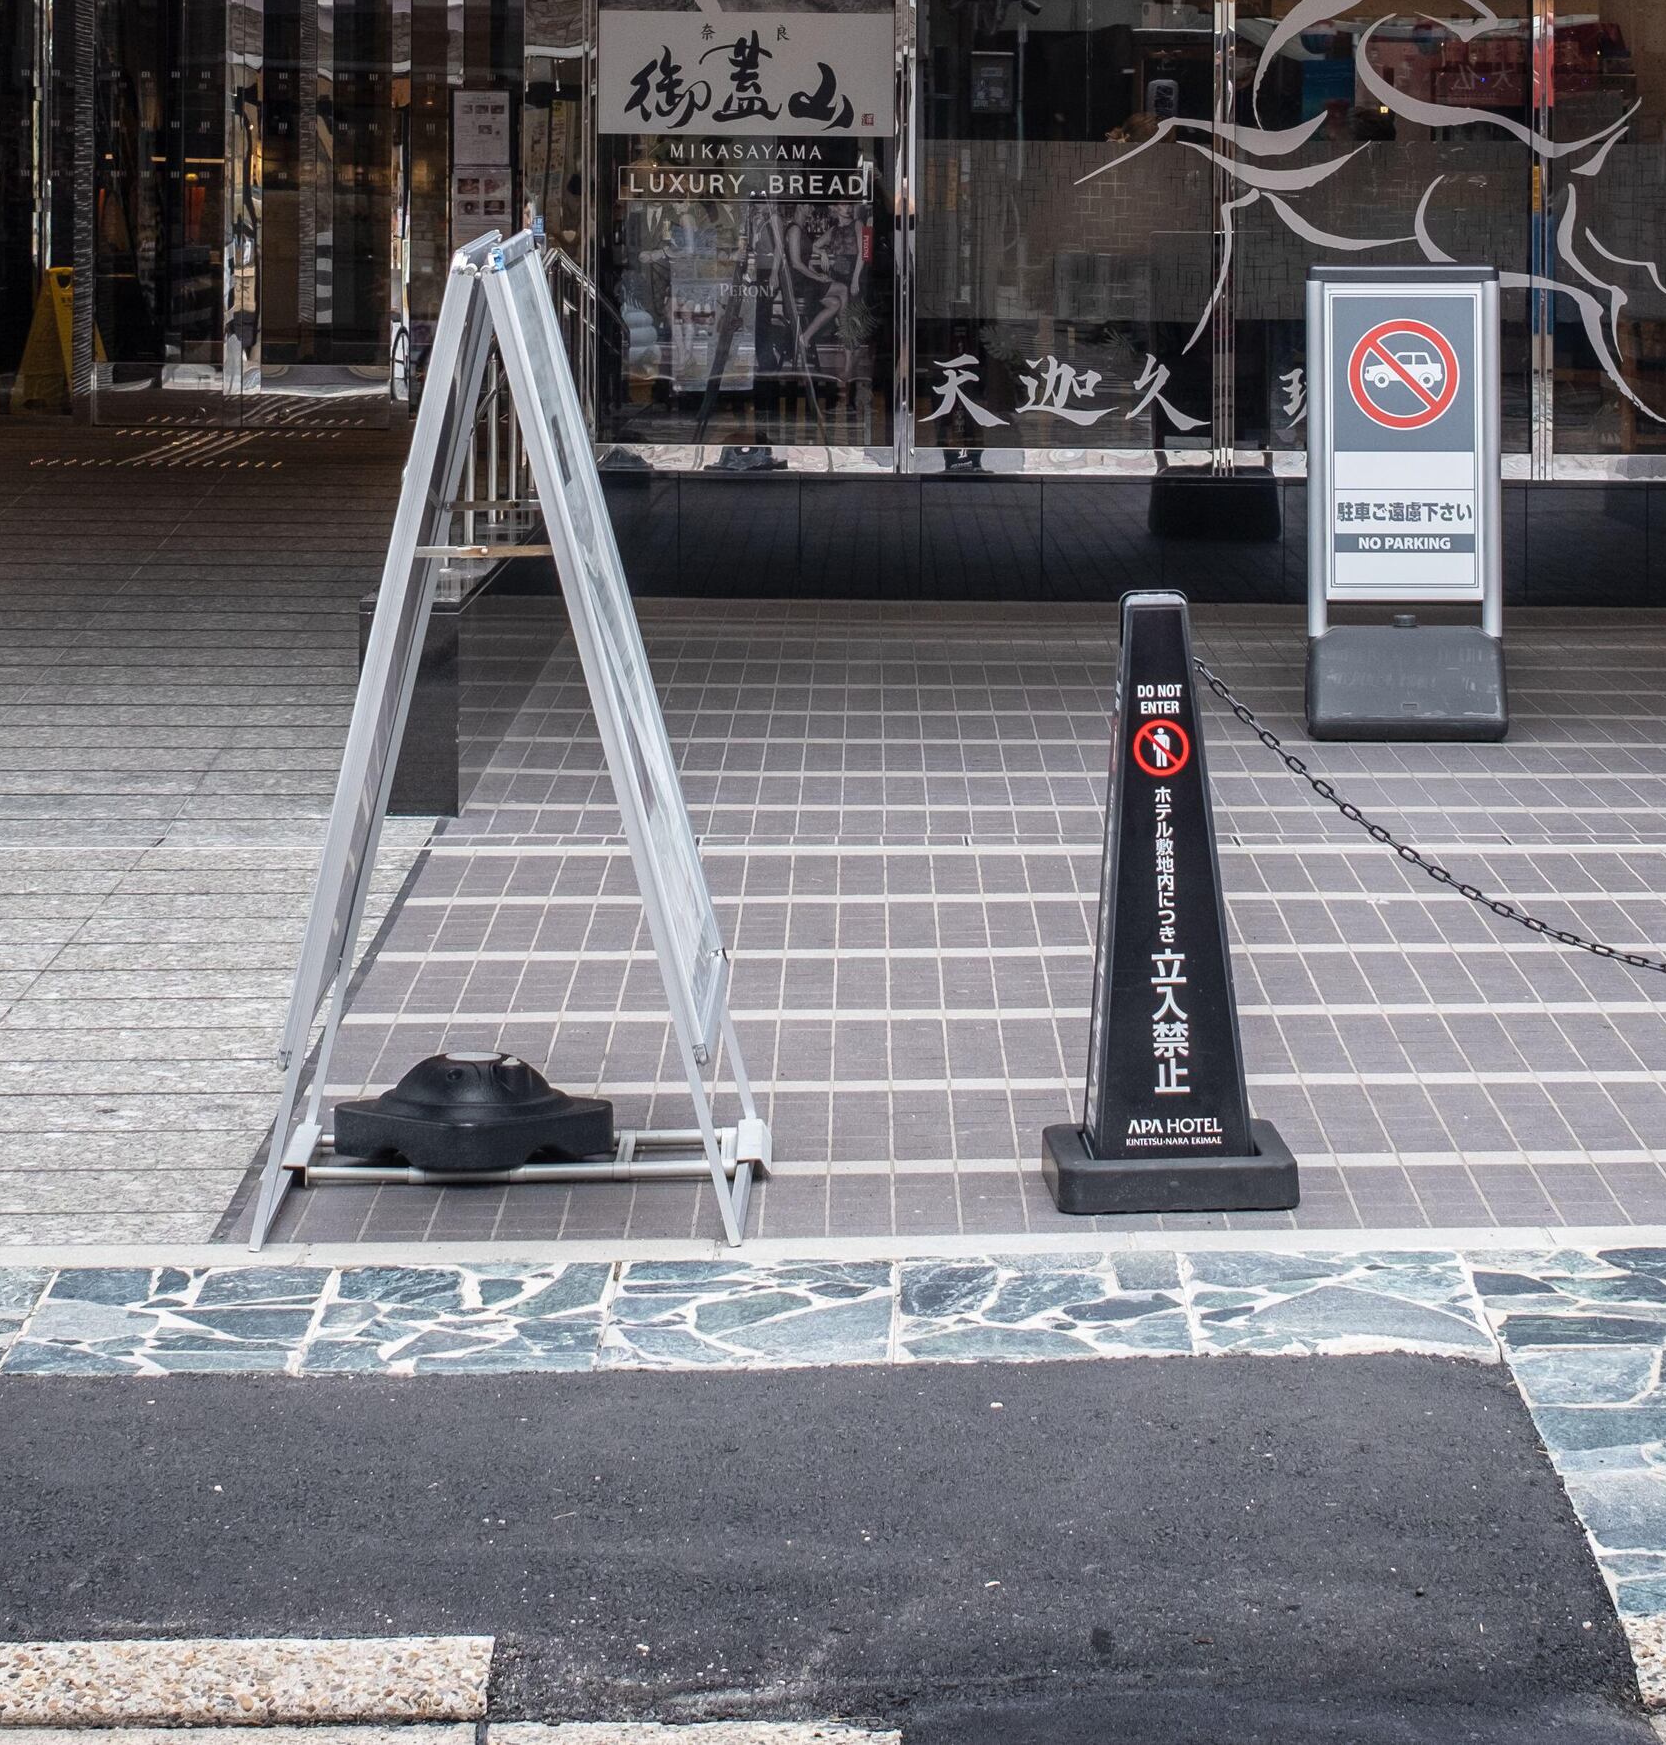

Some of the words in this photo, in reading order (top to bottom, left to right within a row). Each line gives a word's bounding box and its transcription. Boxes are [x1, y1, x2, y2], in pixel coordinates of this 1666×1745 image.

[670, 143, 822, 160] MIKASAYAMA
[630, 173, 745, 194] LUXURY
[769, 175, 865, 195] BREAD
[719, 283, 774, 298] PERONI
[1336, 501, 1473, 523] 駐車ご遠慮下さい
[1358, 537, 1380, 550] NO
[1383, 536, 1451, 550] PARKING
[1137, 684, 1155, 698] DO
[1157, 684, 1183, 697] NOT
[1140, 700, 1180, 714] ENTER
[1150, 949, 1191, 1094] 立入禁止
[1127, 1119, 1164, 1134] APA
[1166, 1117, 1223, 1133] HOTEL
[1191, 1135, 1222, 1145] EKIMAE
